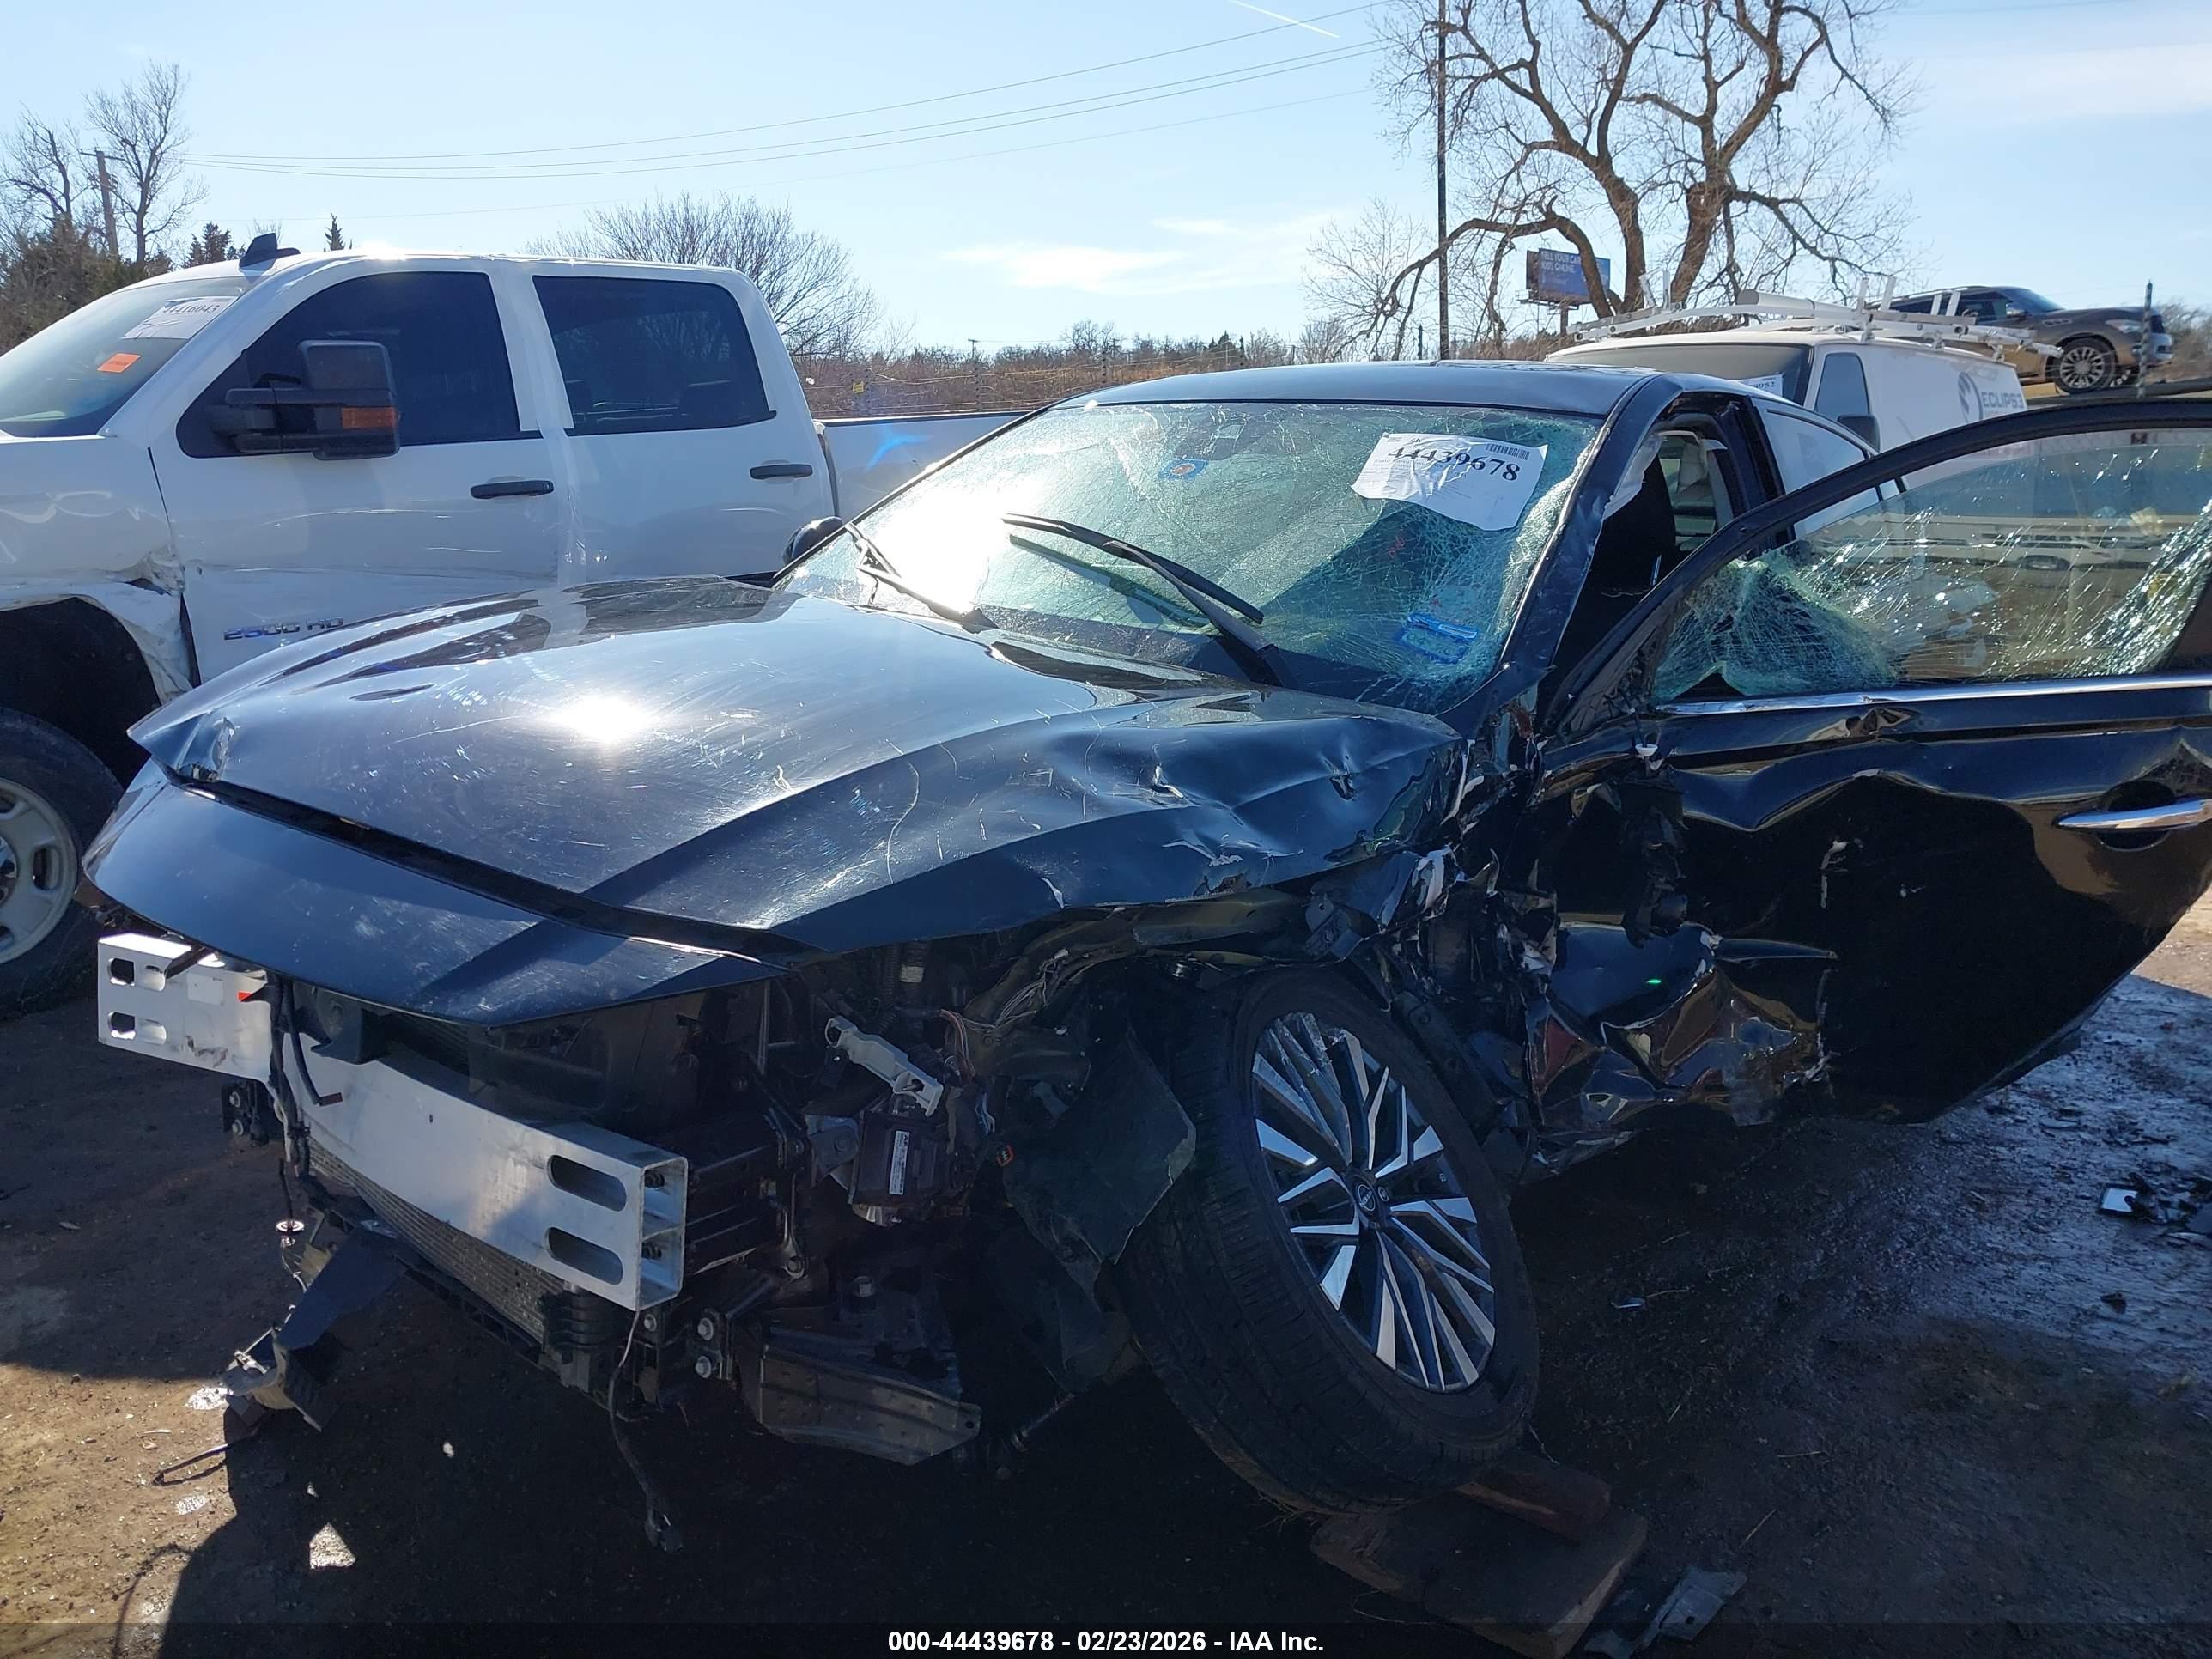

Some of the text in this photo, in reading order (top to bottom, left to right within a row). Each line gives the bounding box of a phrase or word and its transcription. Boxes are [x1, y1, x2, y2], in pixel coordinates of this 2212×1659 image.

[1388, 447, 1521, 481] 44439678
[223, 617, 344, 641] 2500 HD
